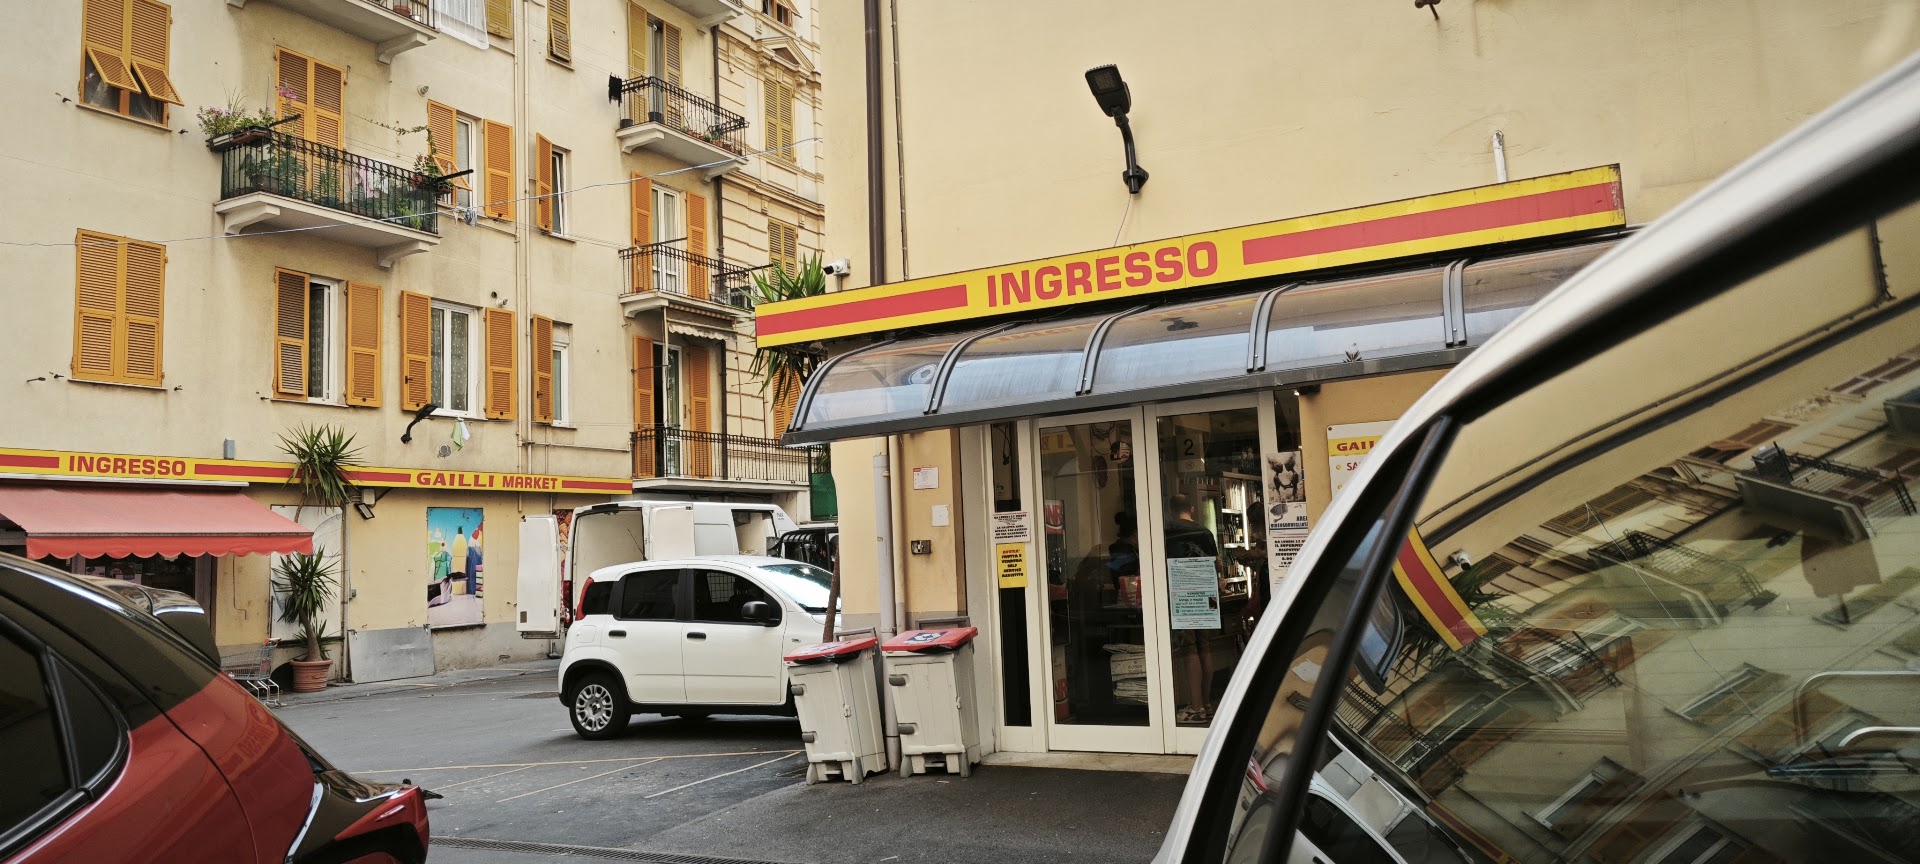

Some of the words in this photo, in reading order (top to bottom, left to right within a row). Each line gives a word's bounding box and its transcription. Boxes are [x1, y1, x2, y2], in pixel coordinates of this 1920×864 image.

[987, 241, 1218, 308] INGRESSO
[1183, 438, 1195, 456] 2
[69, 455, 186, 477] INGRESSO
[1346, 461, 1361, 471] SA
[416, 472, 495, 488] GAILLI
[502, 475, 558, 490] MARKET
